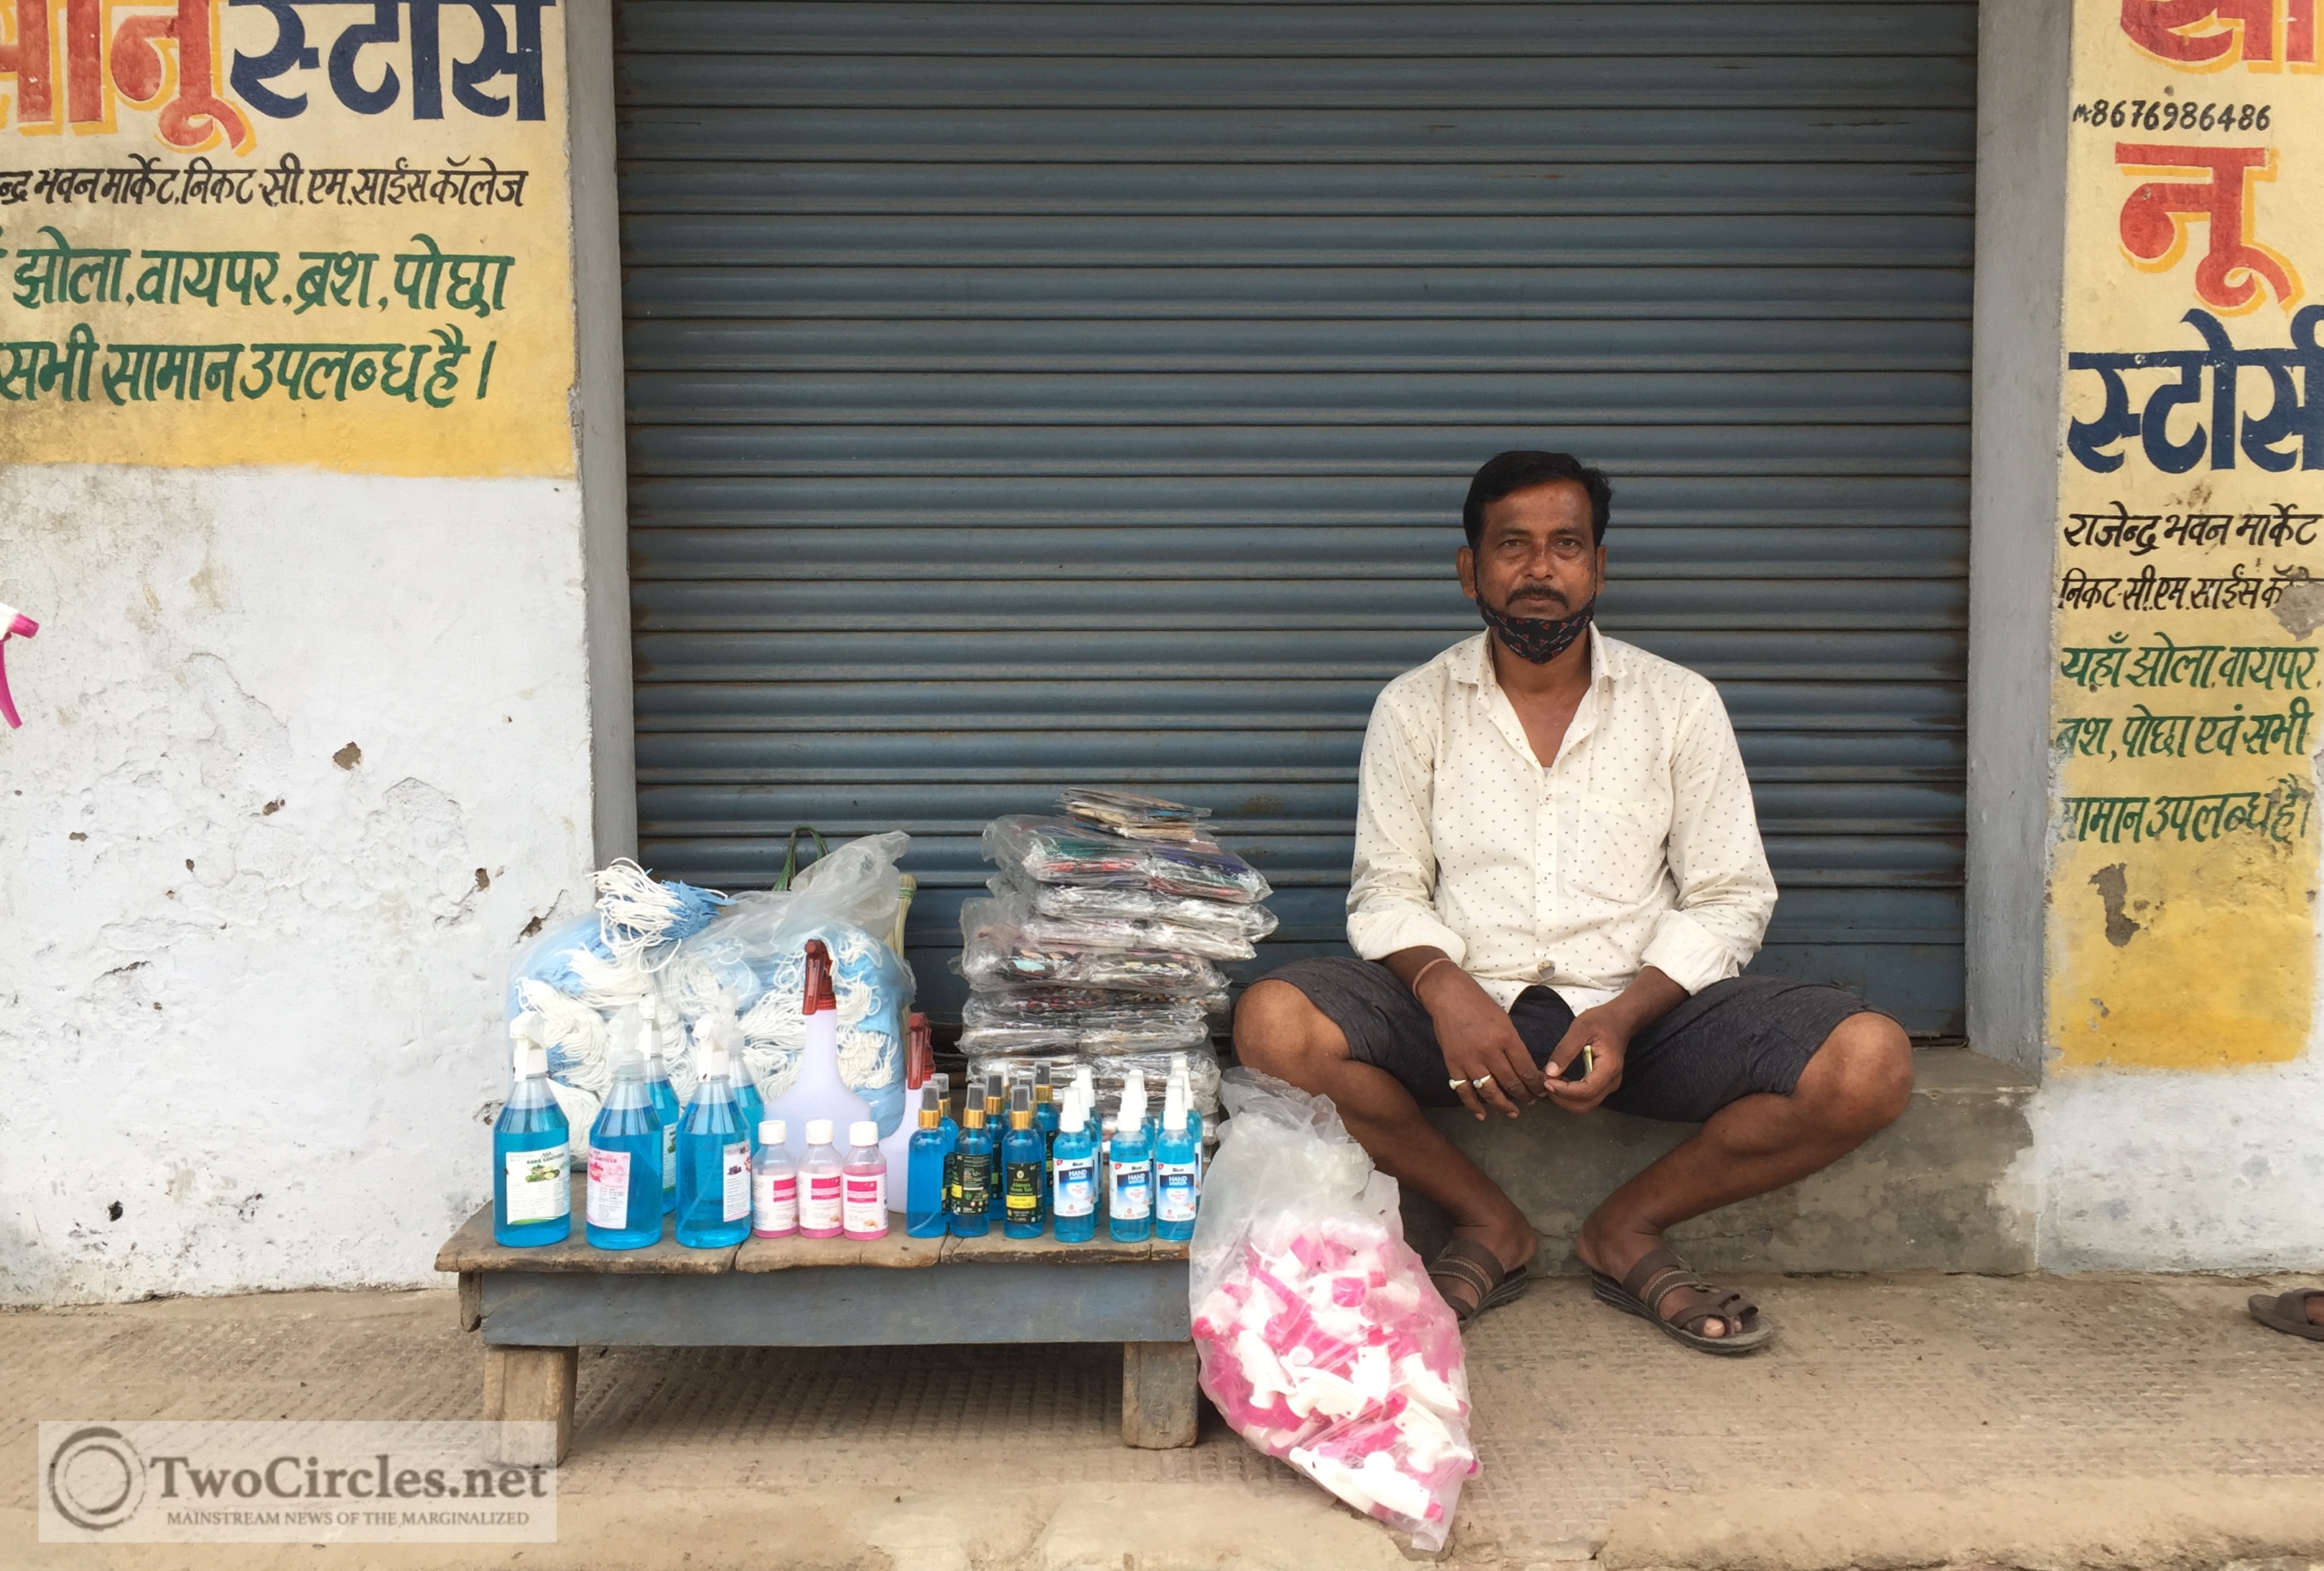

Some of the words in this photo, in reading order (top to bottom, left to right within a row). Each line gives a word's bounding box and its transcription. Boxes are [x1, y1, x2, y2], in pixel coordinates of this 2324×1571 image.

[34, 167, 106, 204] भवन
[180, 156, 257, 205] निकट
[429, 154, 529, 207] कॉलेज
[2116, 142, 2297, 310] नू
[394, 233, 515, 319] पोछा
[0, 323, 100, 402] सभी
[102, 343, 246, 406] सामान
[239, 342, 432, 403] उपलब्ध
[2064, 500, 2162, 556] राजेन्द्र
[2162, 513, 2234, 546] भवन
[2235, 503, 2323, 547] मार्केट
[2058, 567, 2123, 609] निकट
[2060, 631, 2132, 688] यहाँ
[2122, 704, 2195, 758] पोछा
[2195, 703, 2246, 756] एवं
[2242, 696, 2315, 755] सभी
